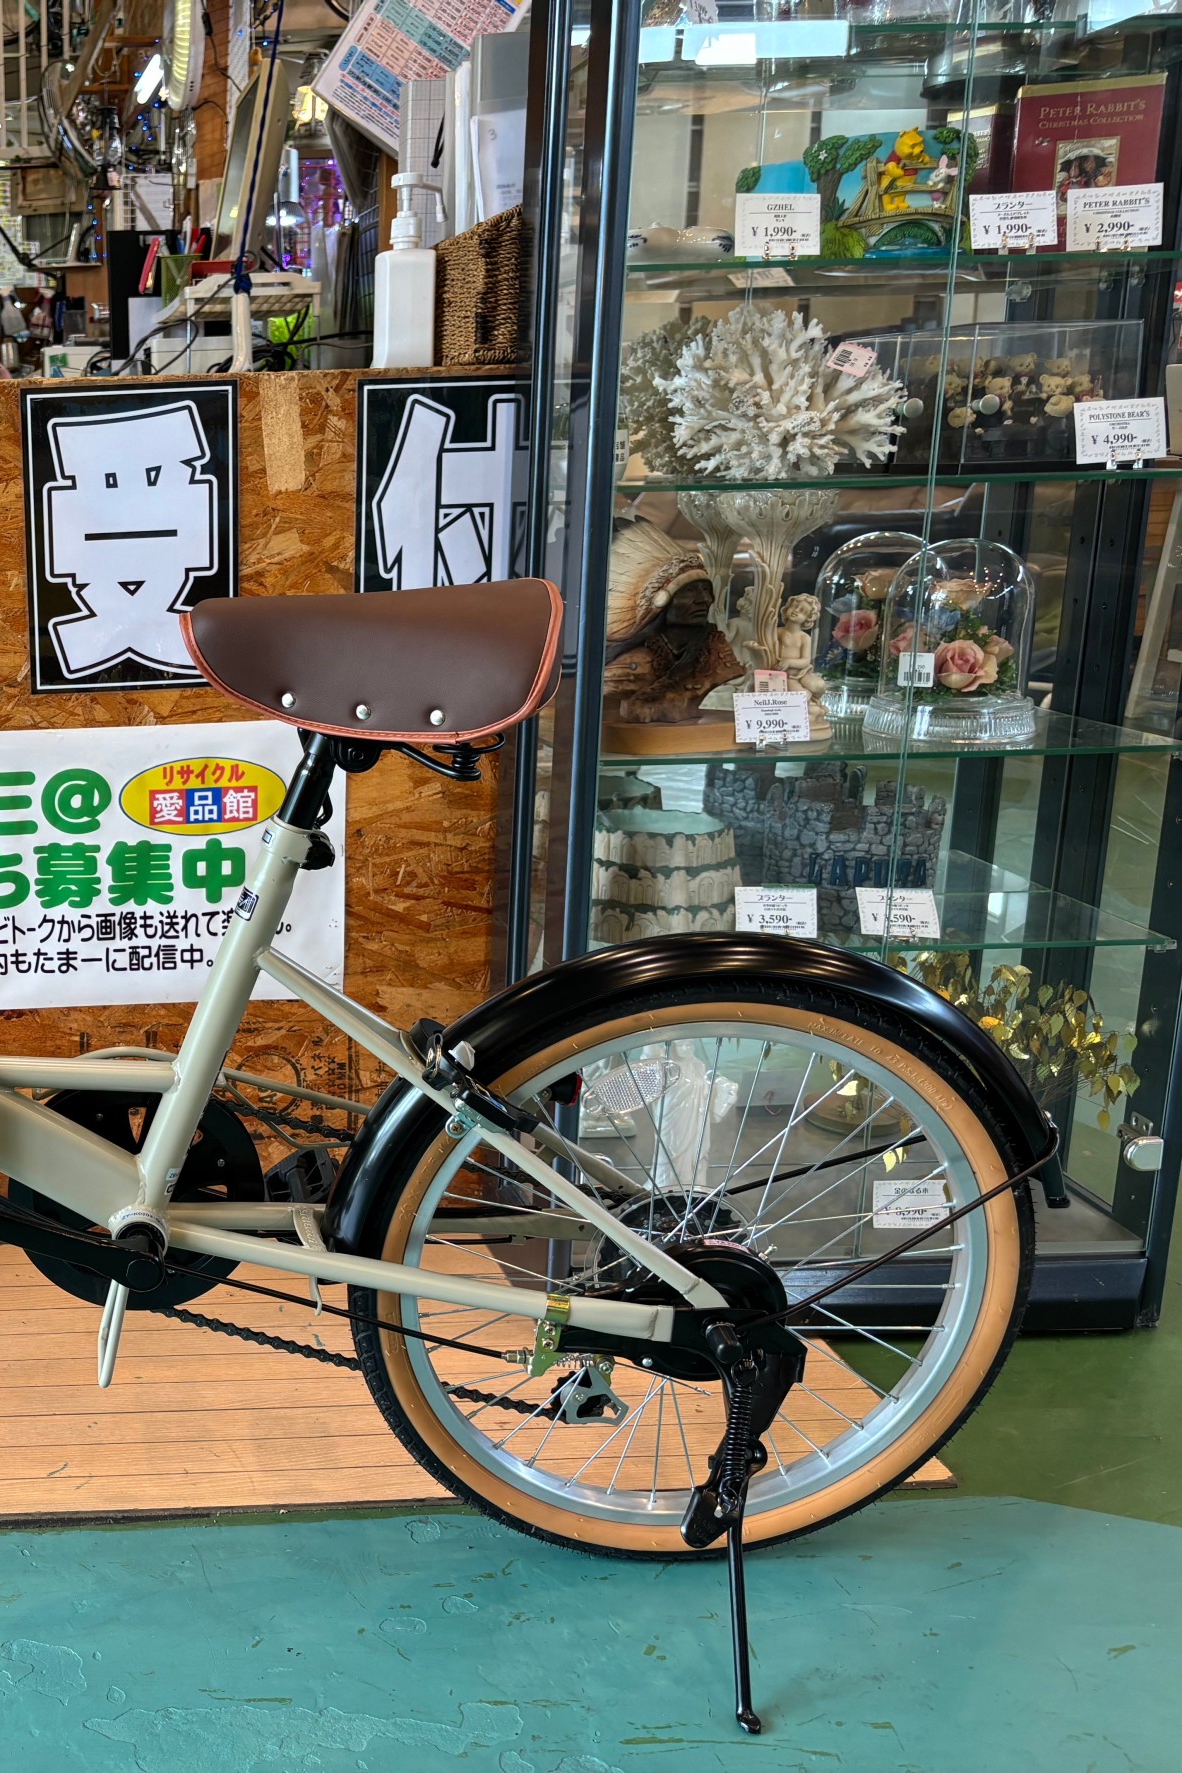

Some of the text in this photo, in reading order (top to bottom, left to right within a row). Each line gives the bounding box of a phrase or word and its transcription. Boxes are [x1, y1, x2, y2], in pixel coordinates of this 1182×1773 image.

[1040, 99, 1146, 119] PETER RABBIT'S
[767, 203, 795, 211] GZHEL
[1083, 197, 1150, 209] PETER RABBIT'S
[1089, 411, 1126, 421] POLYSTONE
[161, 762, 247, 786] リサイクル
[150, 785, 258, 826] 愛品館
